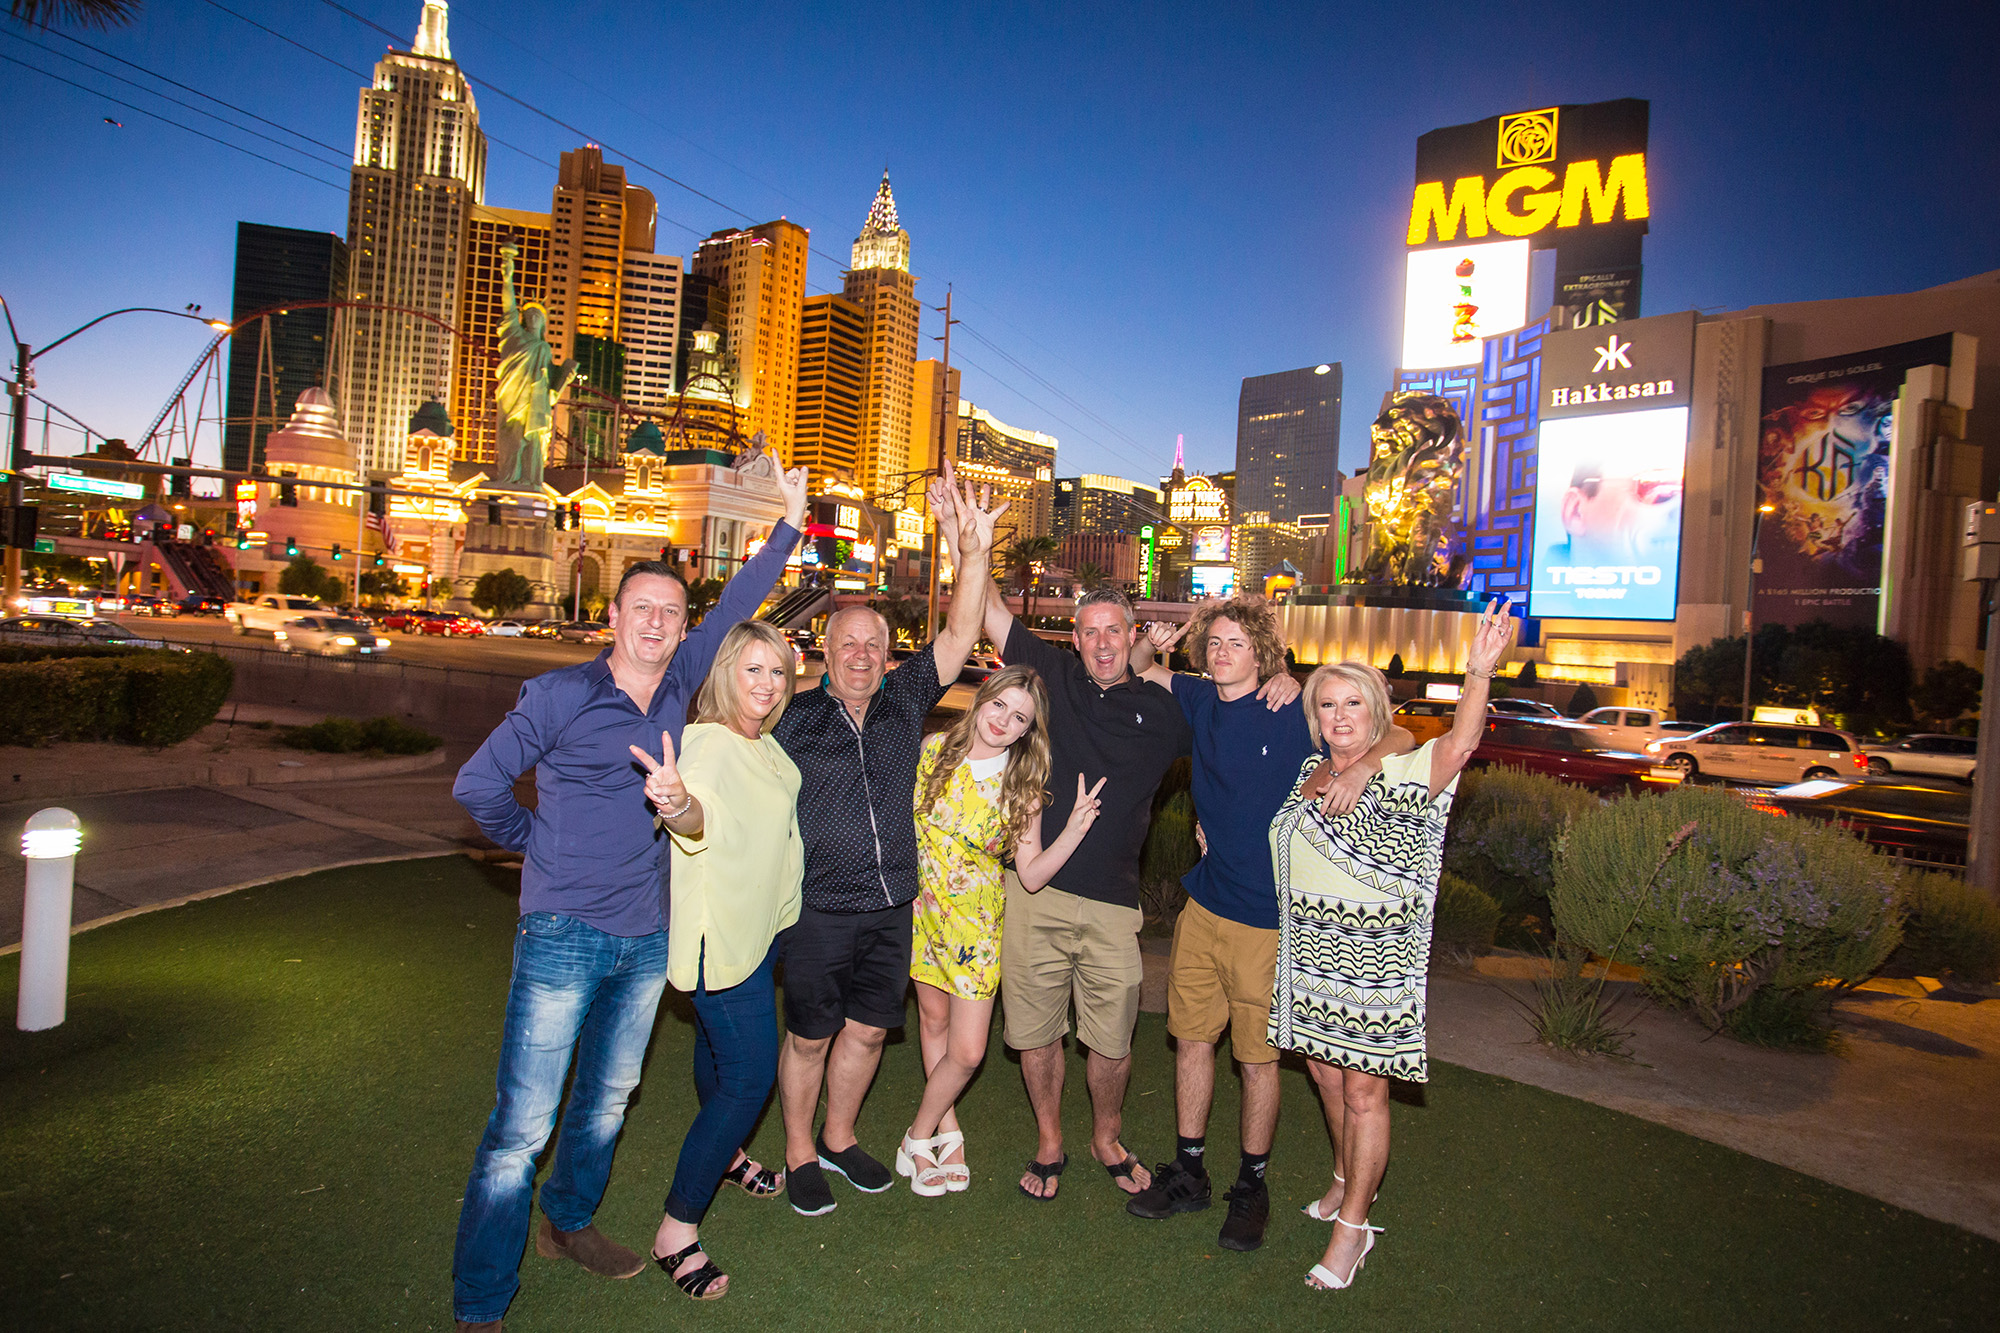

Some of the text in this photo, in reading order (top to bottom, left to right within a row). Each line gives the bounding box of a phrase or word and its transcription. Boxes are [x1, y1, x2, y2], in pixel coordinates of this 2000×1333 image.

[1406, 153, 1650, 246] MGM
[1563, 279, 1632, 292] EXTRAORDINARY
[1786, 361, 1883, 385] CIRQUE DU SOLEIL
[1551, 379, 1675, 407] Hakkasan
[1171, 490, 1221, 503] NEW YORK
[1170, 505, 1221, 518] NEW YORK
[1140, 543, 1150, 573] SHACK
[1791, 587, 1828, 596] MILLION
[1829, 586, 1882, 596] PRODUCTIO
